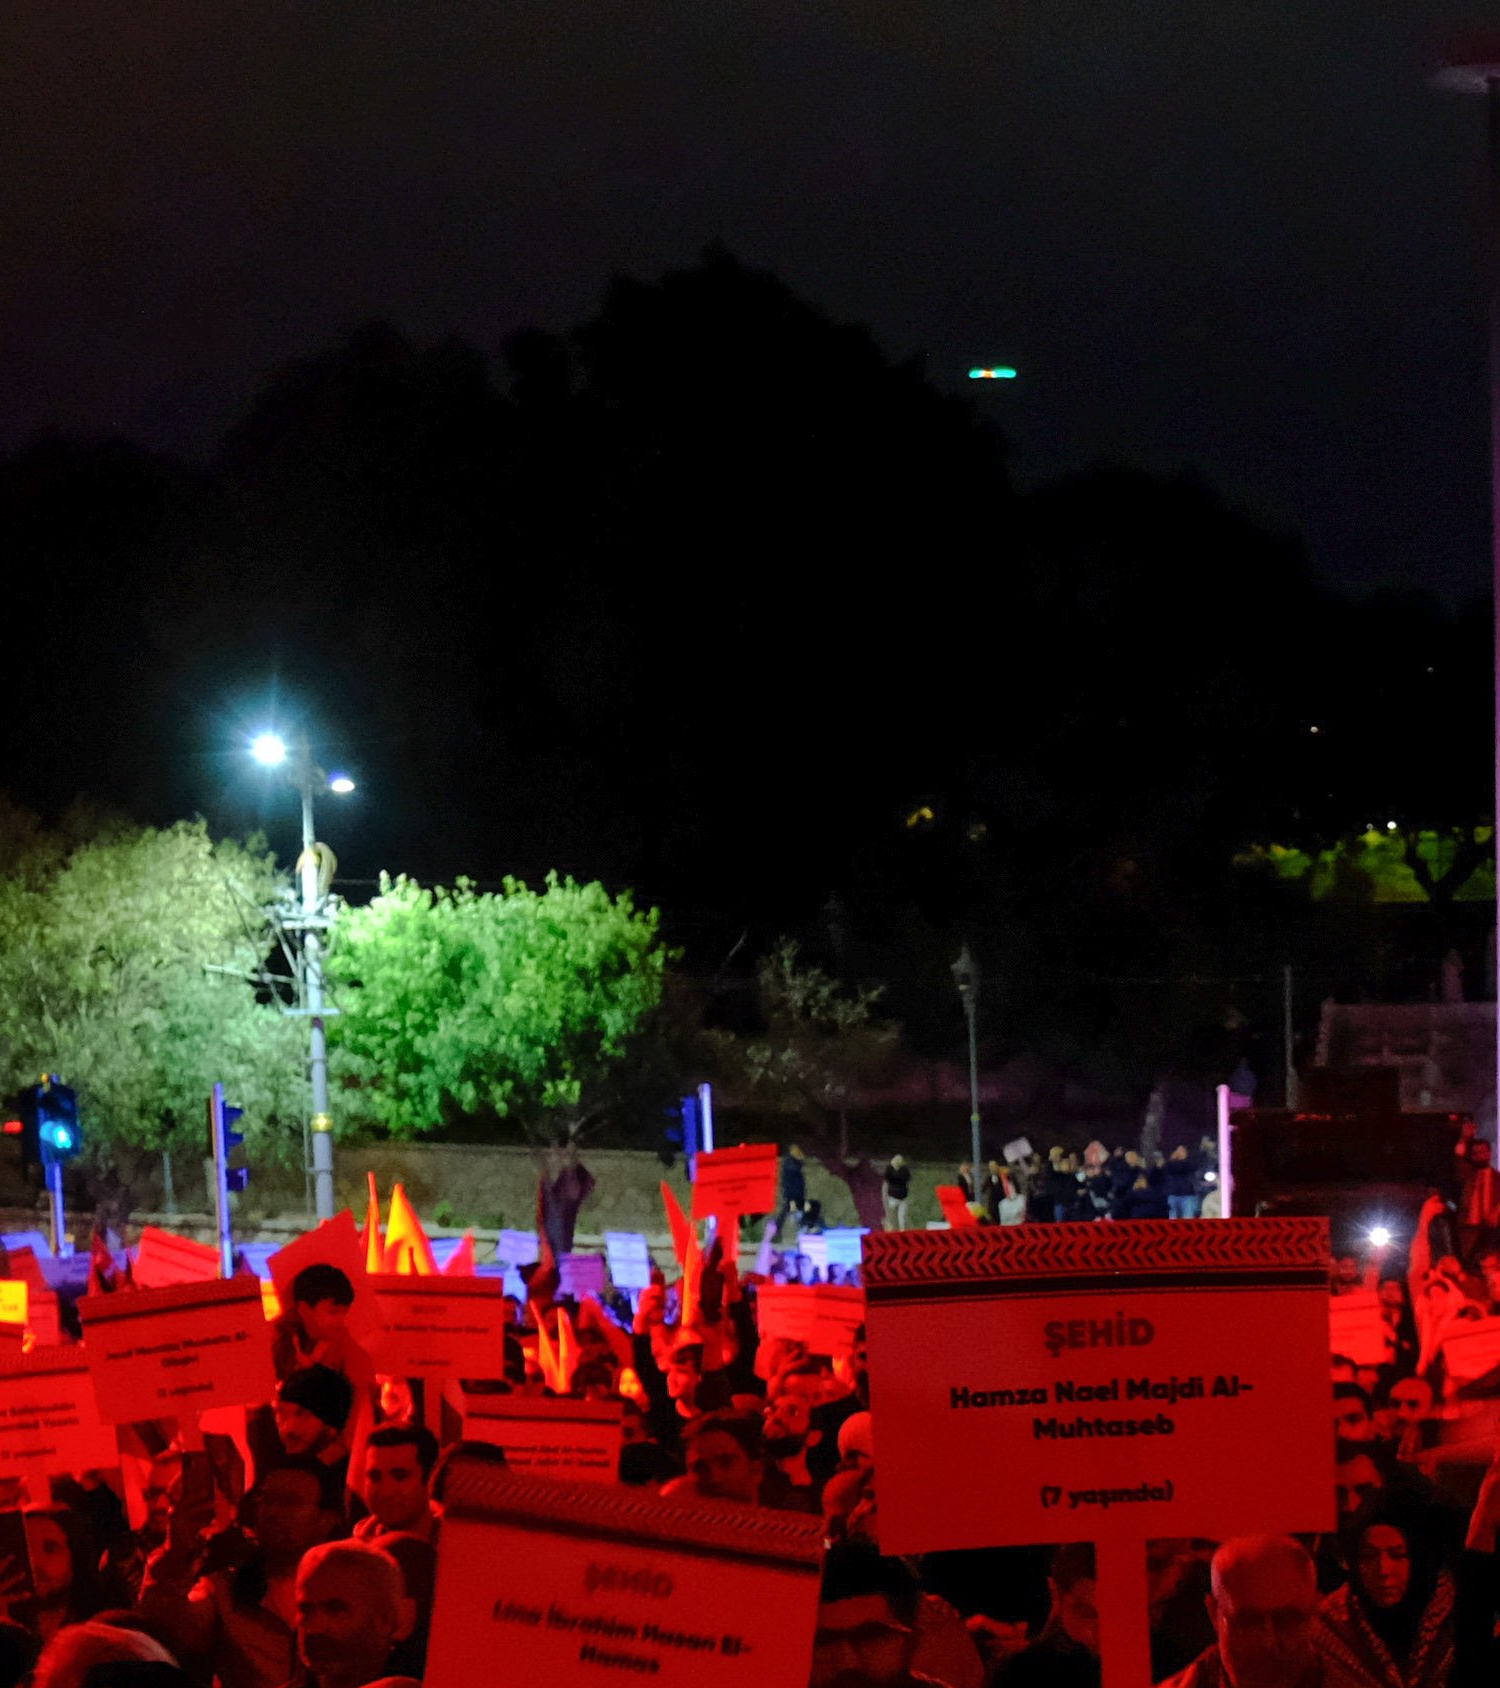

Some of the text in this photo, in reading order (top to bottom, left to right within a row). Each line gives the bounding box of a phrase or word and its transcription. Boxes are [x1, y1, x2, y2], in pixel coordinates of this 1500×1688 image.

[1044, 1311, 1155, 1358] ŞEHİD
[950, 1375, 1253, 1409] Hamza Nael Majdi Al-
[1033, 1413, 1175, 1440] Muhtaseb
[1040, 1480, 1174, 1509] (7 yaşında)
